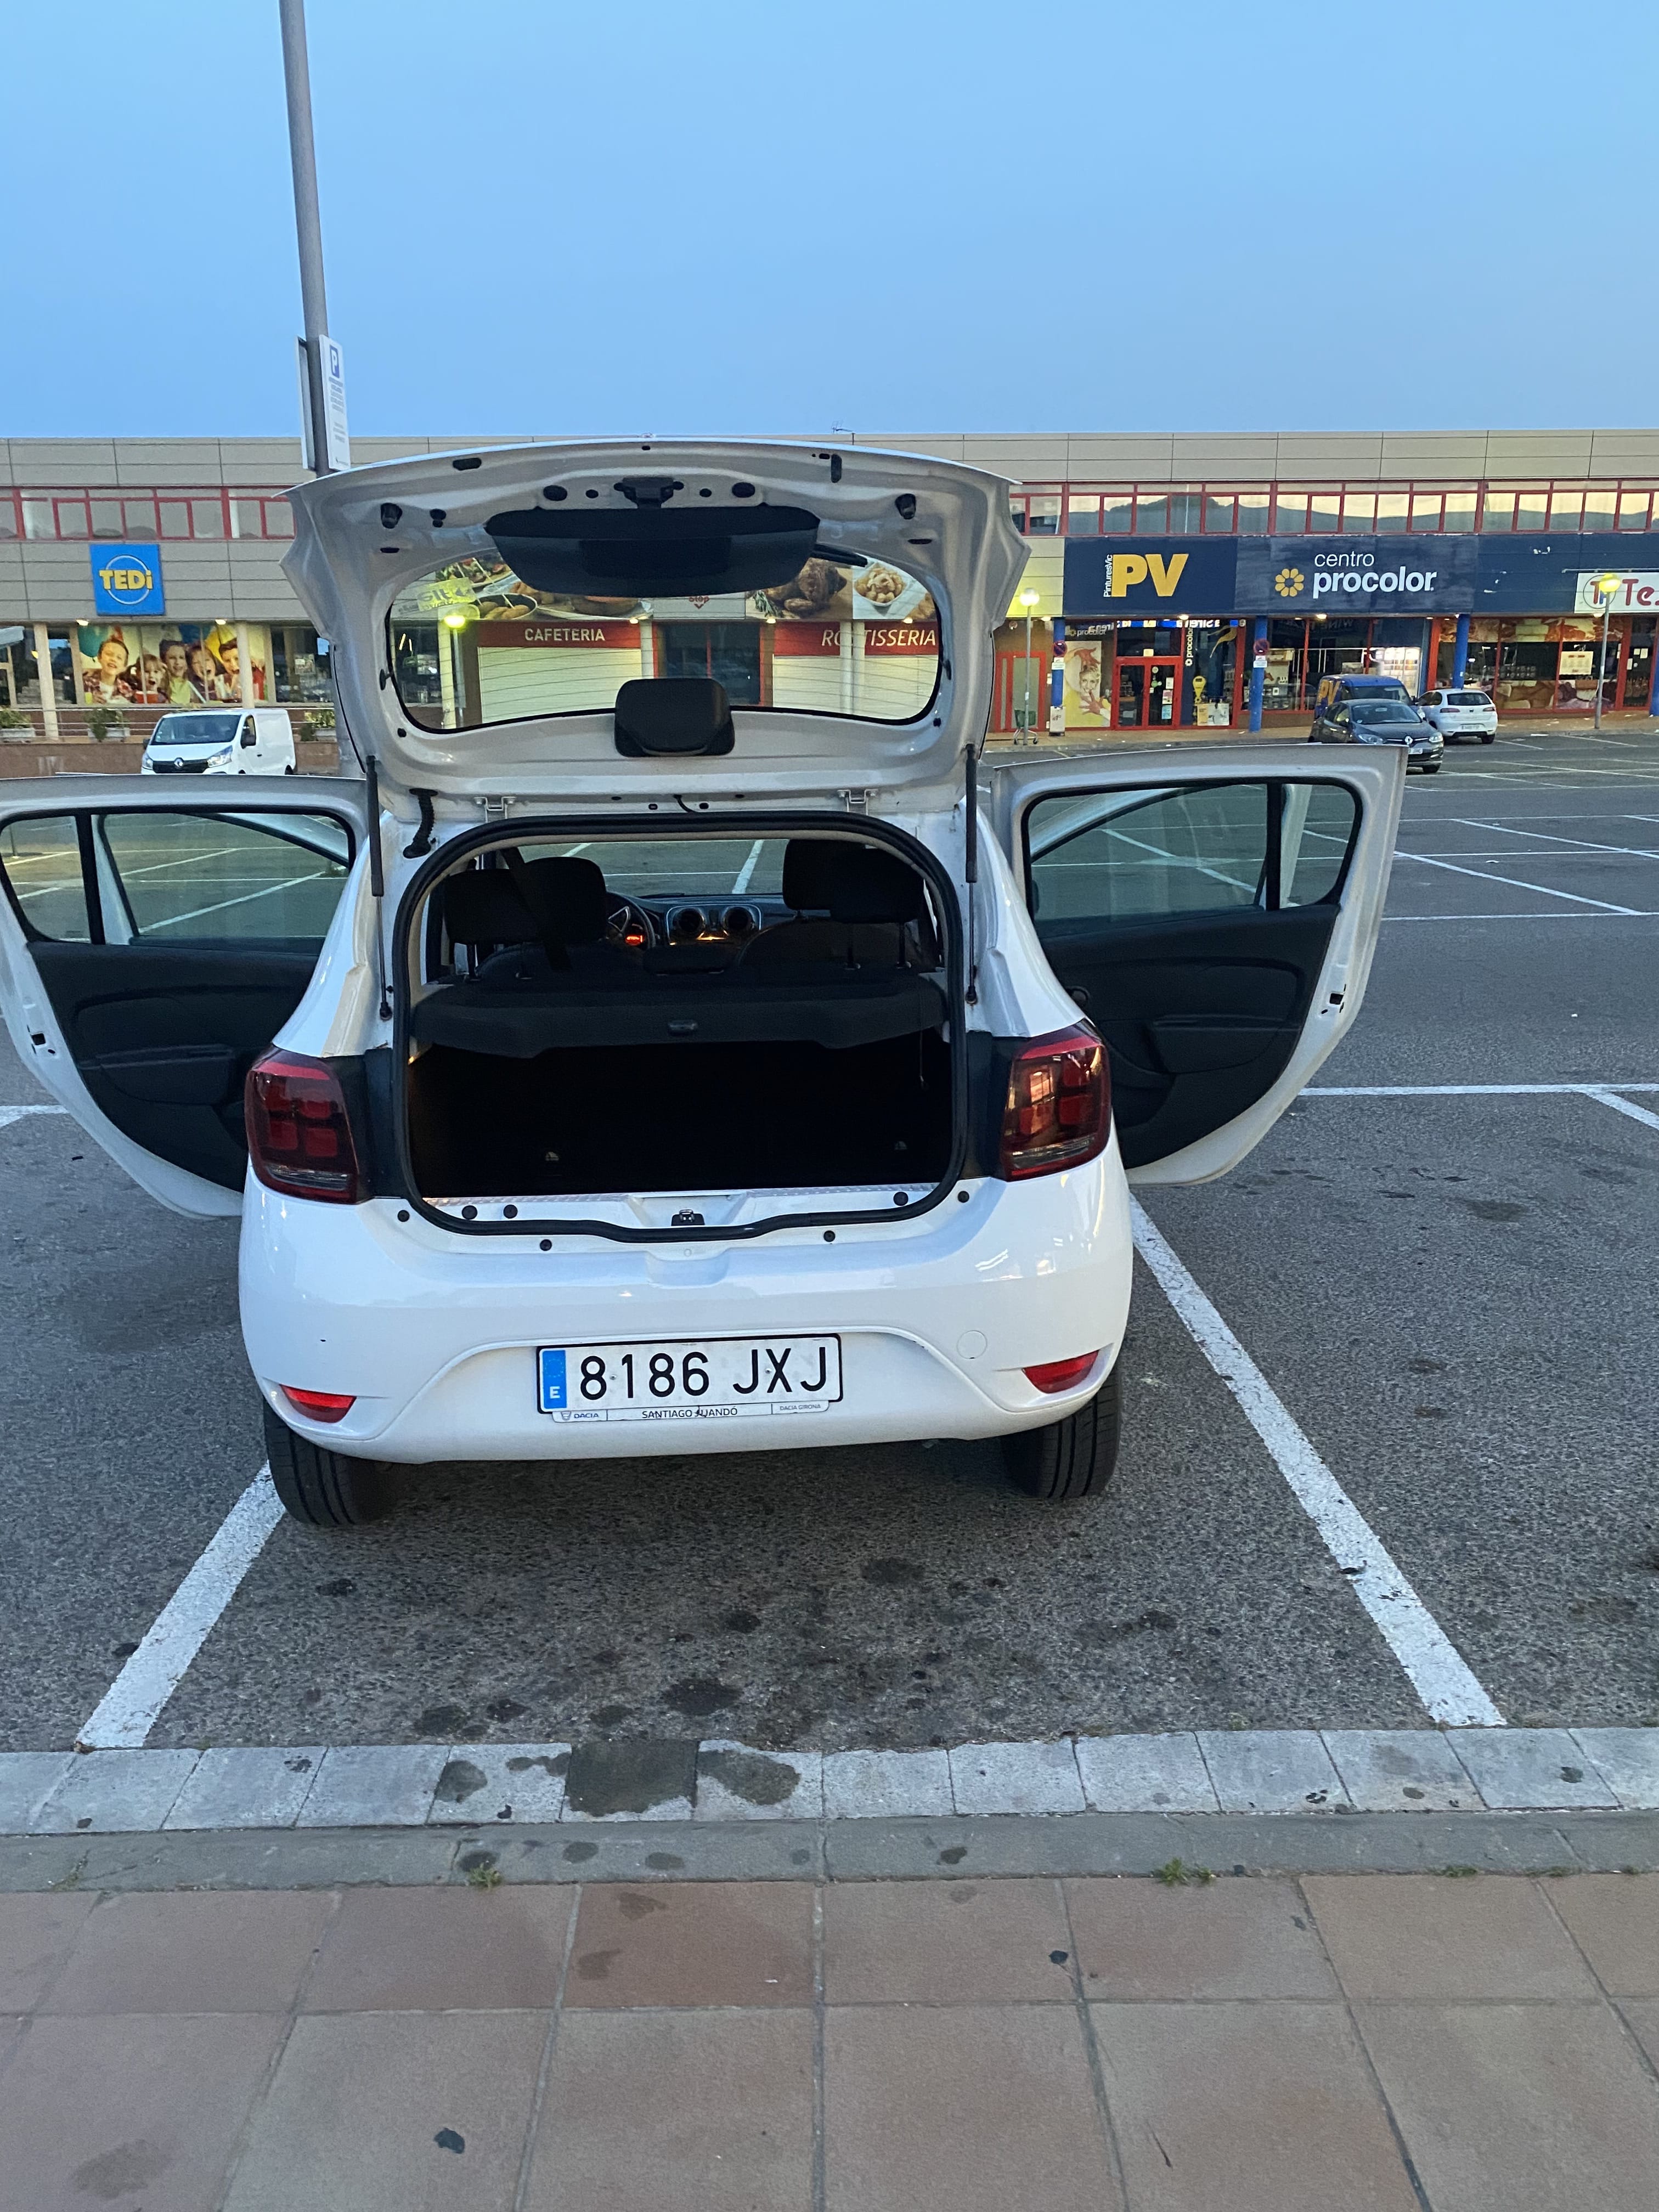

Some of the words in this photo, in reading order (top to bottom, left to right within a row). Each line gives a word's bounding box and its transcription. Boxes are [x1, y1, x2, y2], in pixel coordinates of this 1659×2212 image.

[1314, 550, 1375, 567] centro
[99, 569, 153, 590] TEDi
[1103, 554, 1113, 597] PinturesVic
[1111, 553, 1189, 597] PV
[1622, 578, 1659, 606] Te
[524, 628, 606, 641] CAFETERIA
[821, 629, 936, 646] RTISSERIA
[580, 1351, 710, 1400] 8186
[732, 1346, 826, 1395] JXJ
[550, 1386, 560, 1399] E
[642, 1409, 692, 1419] SANTIAGO
